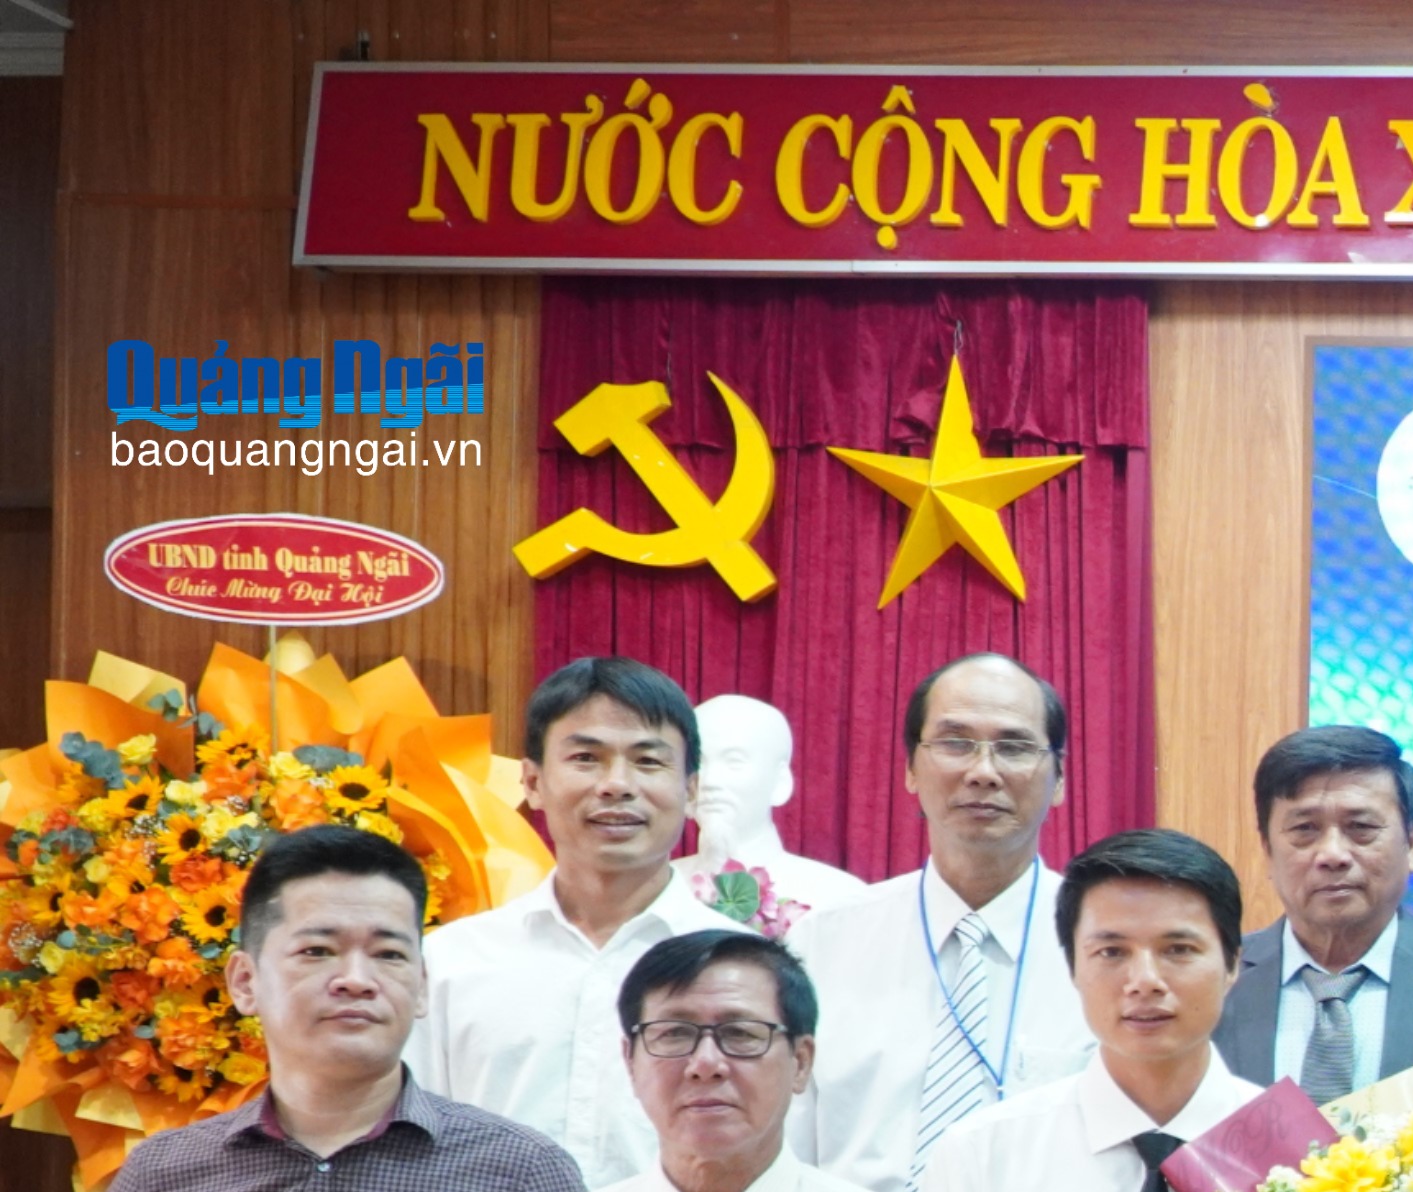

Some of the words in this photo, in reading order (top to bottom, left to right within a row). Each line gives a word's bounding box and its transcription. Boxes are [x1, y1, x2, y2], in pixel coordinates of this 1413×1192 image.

[408, 78, 742, 225] NƯỚC
[775, 85, 1101, 249] CỘNG
[1128, 83, 1370, 229] HÒA
[147, 543, 216, 570] UBND
[275, 546, 351, 579] Quảng
[357, 550, 411, 582] Ngãi
